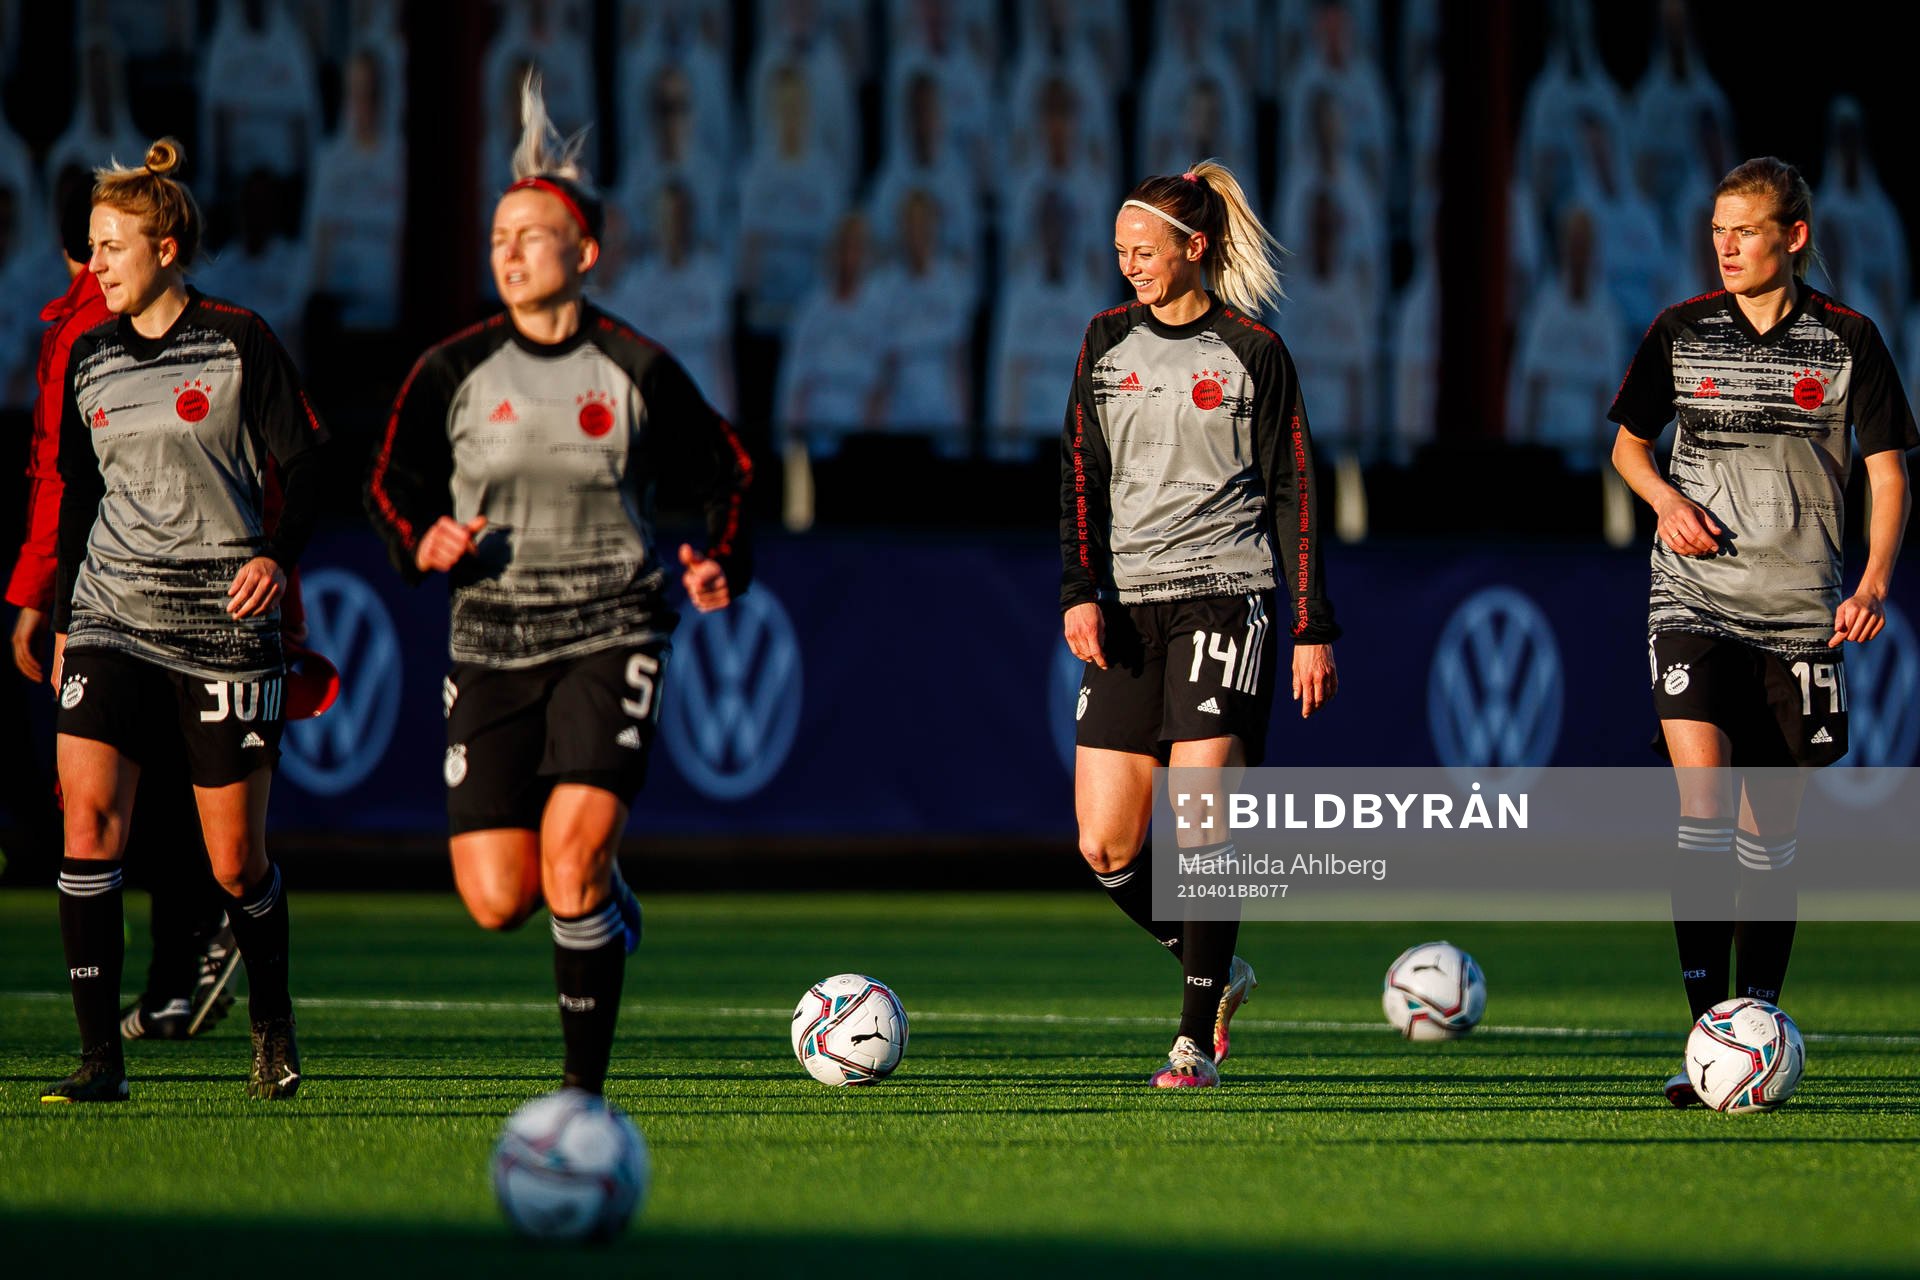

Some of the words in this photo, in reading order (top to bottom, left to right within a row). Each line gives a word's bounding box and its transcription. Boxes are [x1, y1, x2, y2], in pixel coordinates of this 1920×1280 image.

[1291, 415, 1301, 429] FC
[1292, 431, 1306, 472] BAYERN
[1299, 493, 1309, 533] BAYERN
[1299, 537, 1309, 551] FC
[1298, 553, 1309, 592] BAYERN
[1189, 630, 1237, 688] 14
[621, 653, 658, 720] 5
[1791, 661, 1838, 715] 19
[70, 966, 99, 980] FCB
[1187, 975, 1213, 987] FCB
[1683, 969, 1707, 980] FCB
[1747, 986, 1775, 999] FCB
